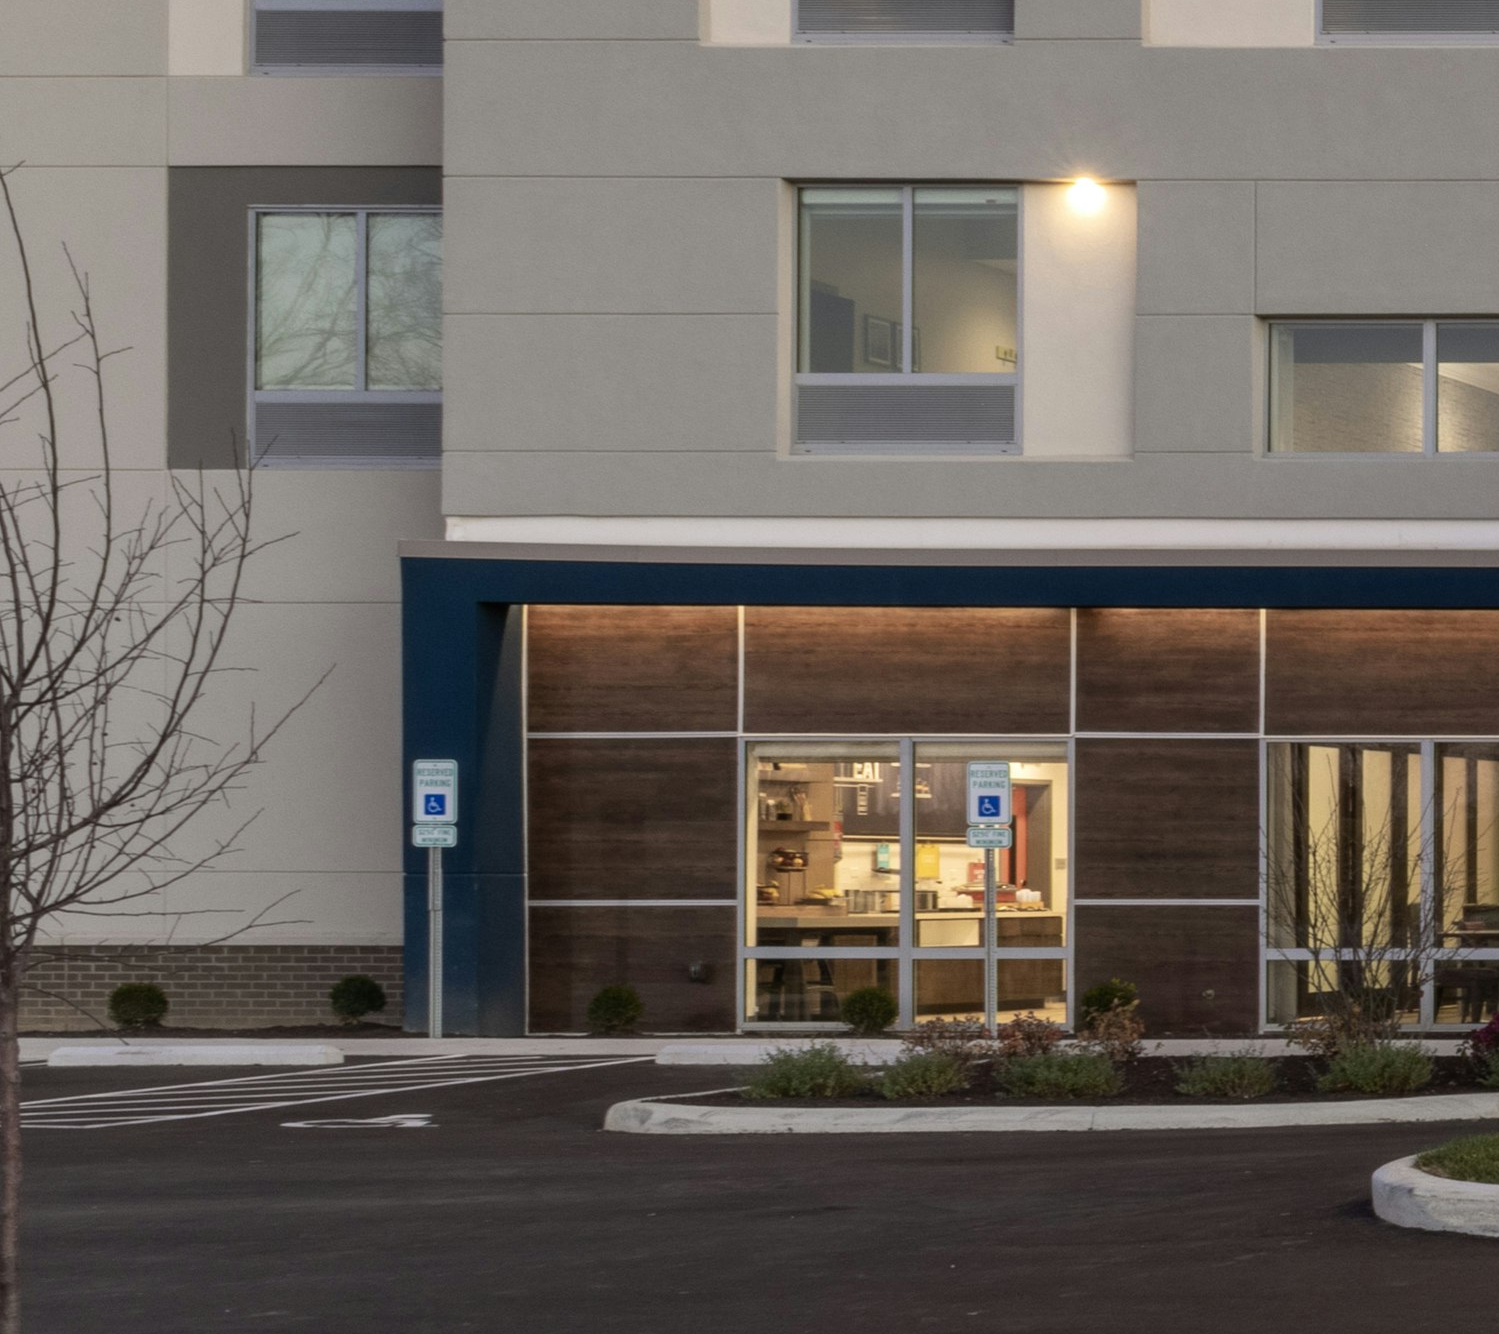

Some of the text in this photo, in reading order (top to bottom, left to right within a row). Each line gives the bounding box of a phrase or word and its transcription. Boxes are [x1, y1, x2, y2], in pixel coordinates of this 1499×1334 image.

[417, 768, 454, 776] RESERVED
[970, 770, 1008, 778] RESERVED
[419, 779, 452, 787] PARKING
